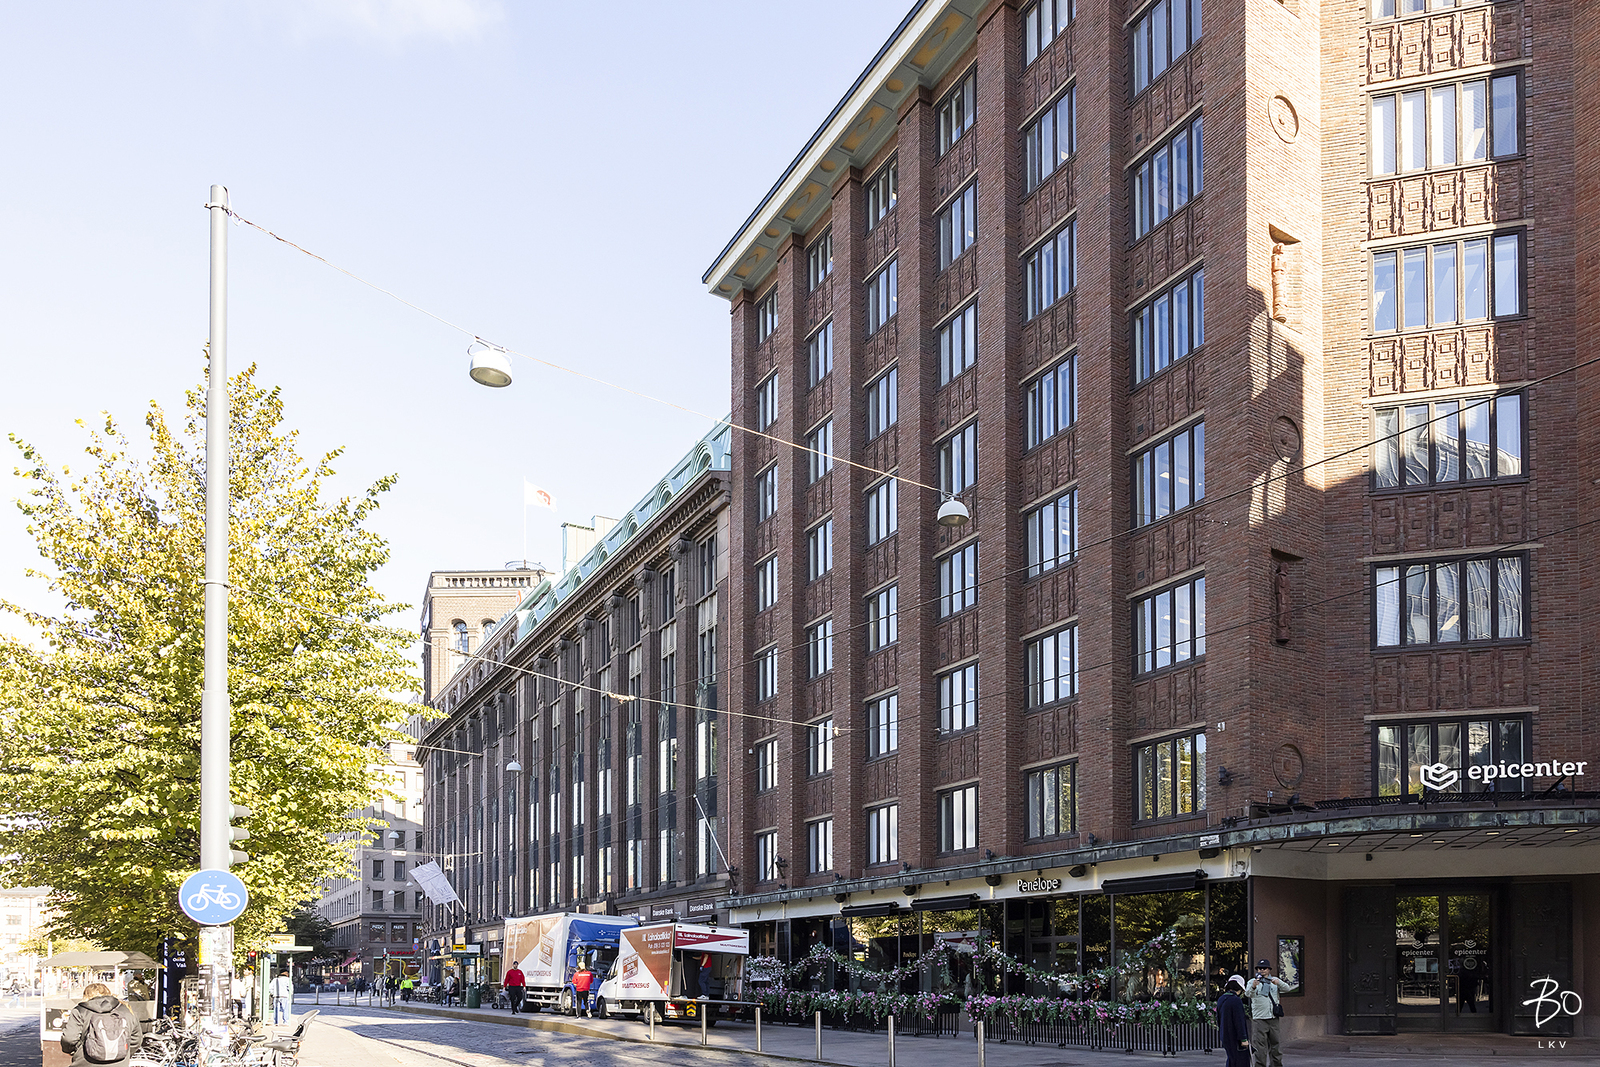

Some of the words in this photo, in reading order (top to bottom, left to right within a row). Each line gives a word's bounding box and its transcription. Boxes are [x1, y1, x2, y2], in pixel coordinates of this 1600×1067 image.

[1467, 759, 1588, 784] epicenter
[1016, 877, 1059, 892] Penélope
[703, 903, 714, 911] Bank
[756, 908, 762, 919] 9
